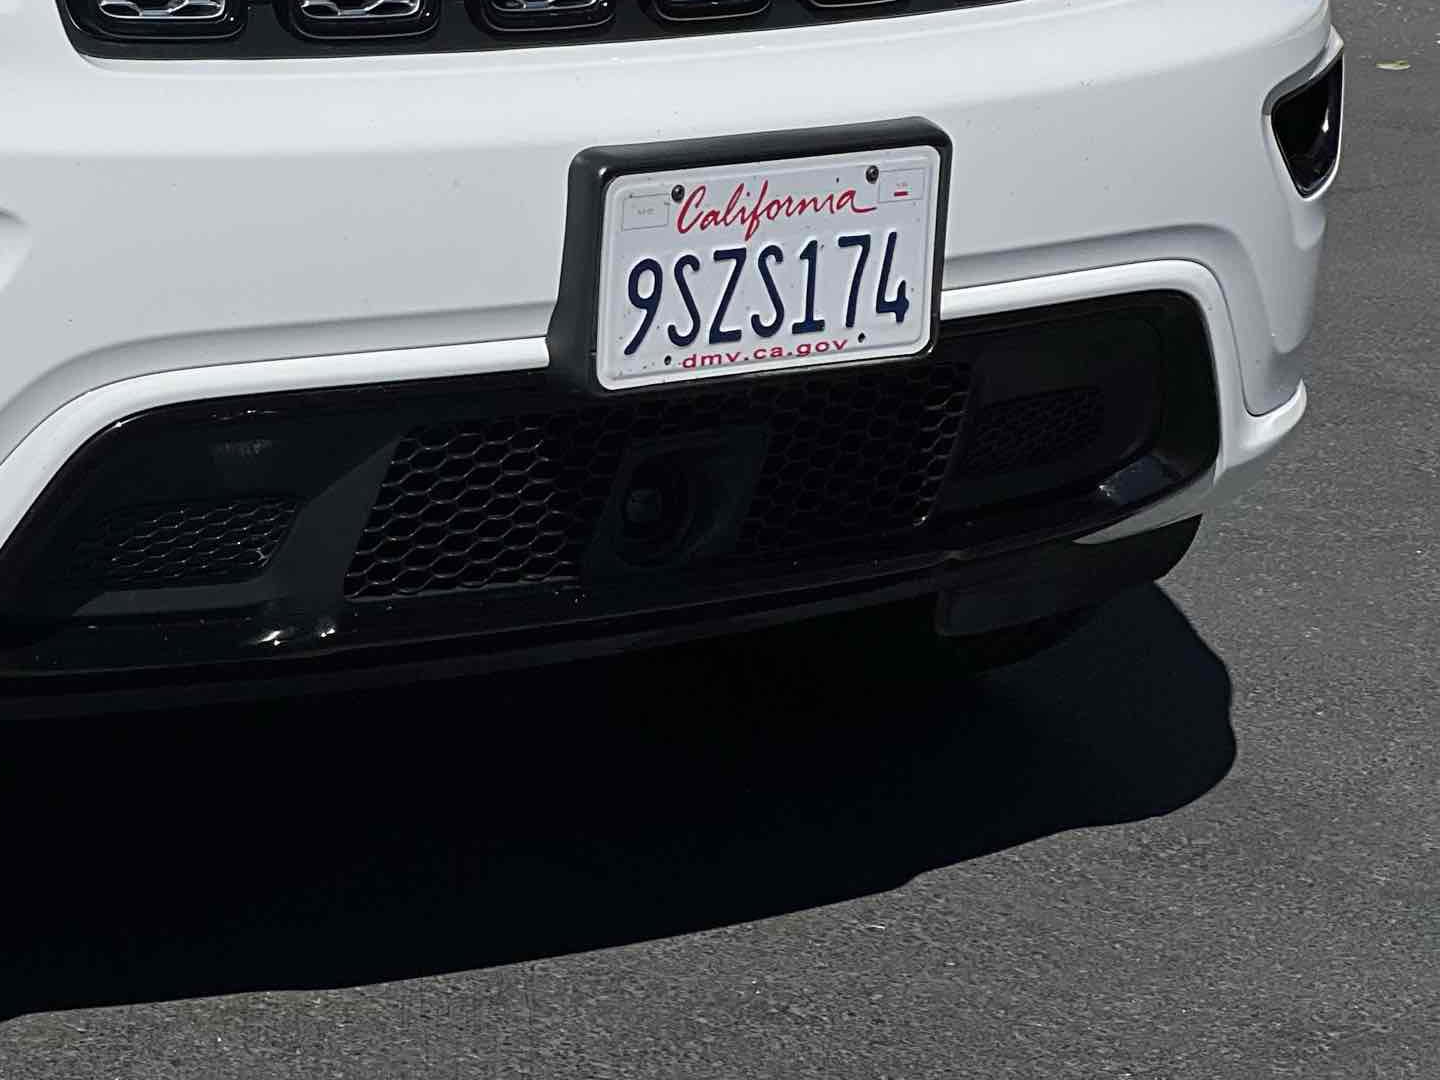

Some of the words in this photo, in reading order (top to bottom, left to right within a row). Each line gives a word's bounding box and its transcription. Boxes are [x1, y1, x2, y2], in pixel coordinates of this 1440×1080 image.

[676, 180, 878, 242] California
[623, 231, 911, 356] 9SZS174
[681, 338, 848, 370] dmv.ca.gov
